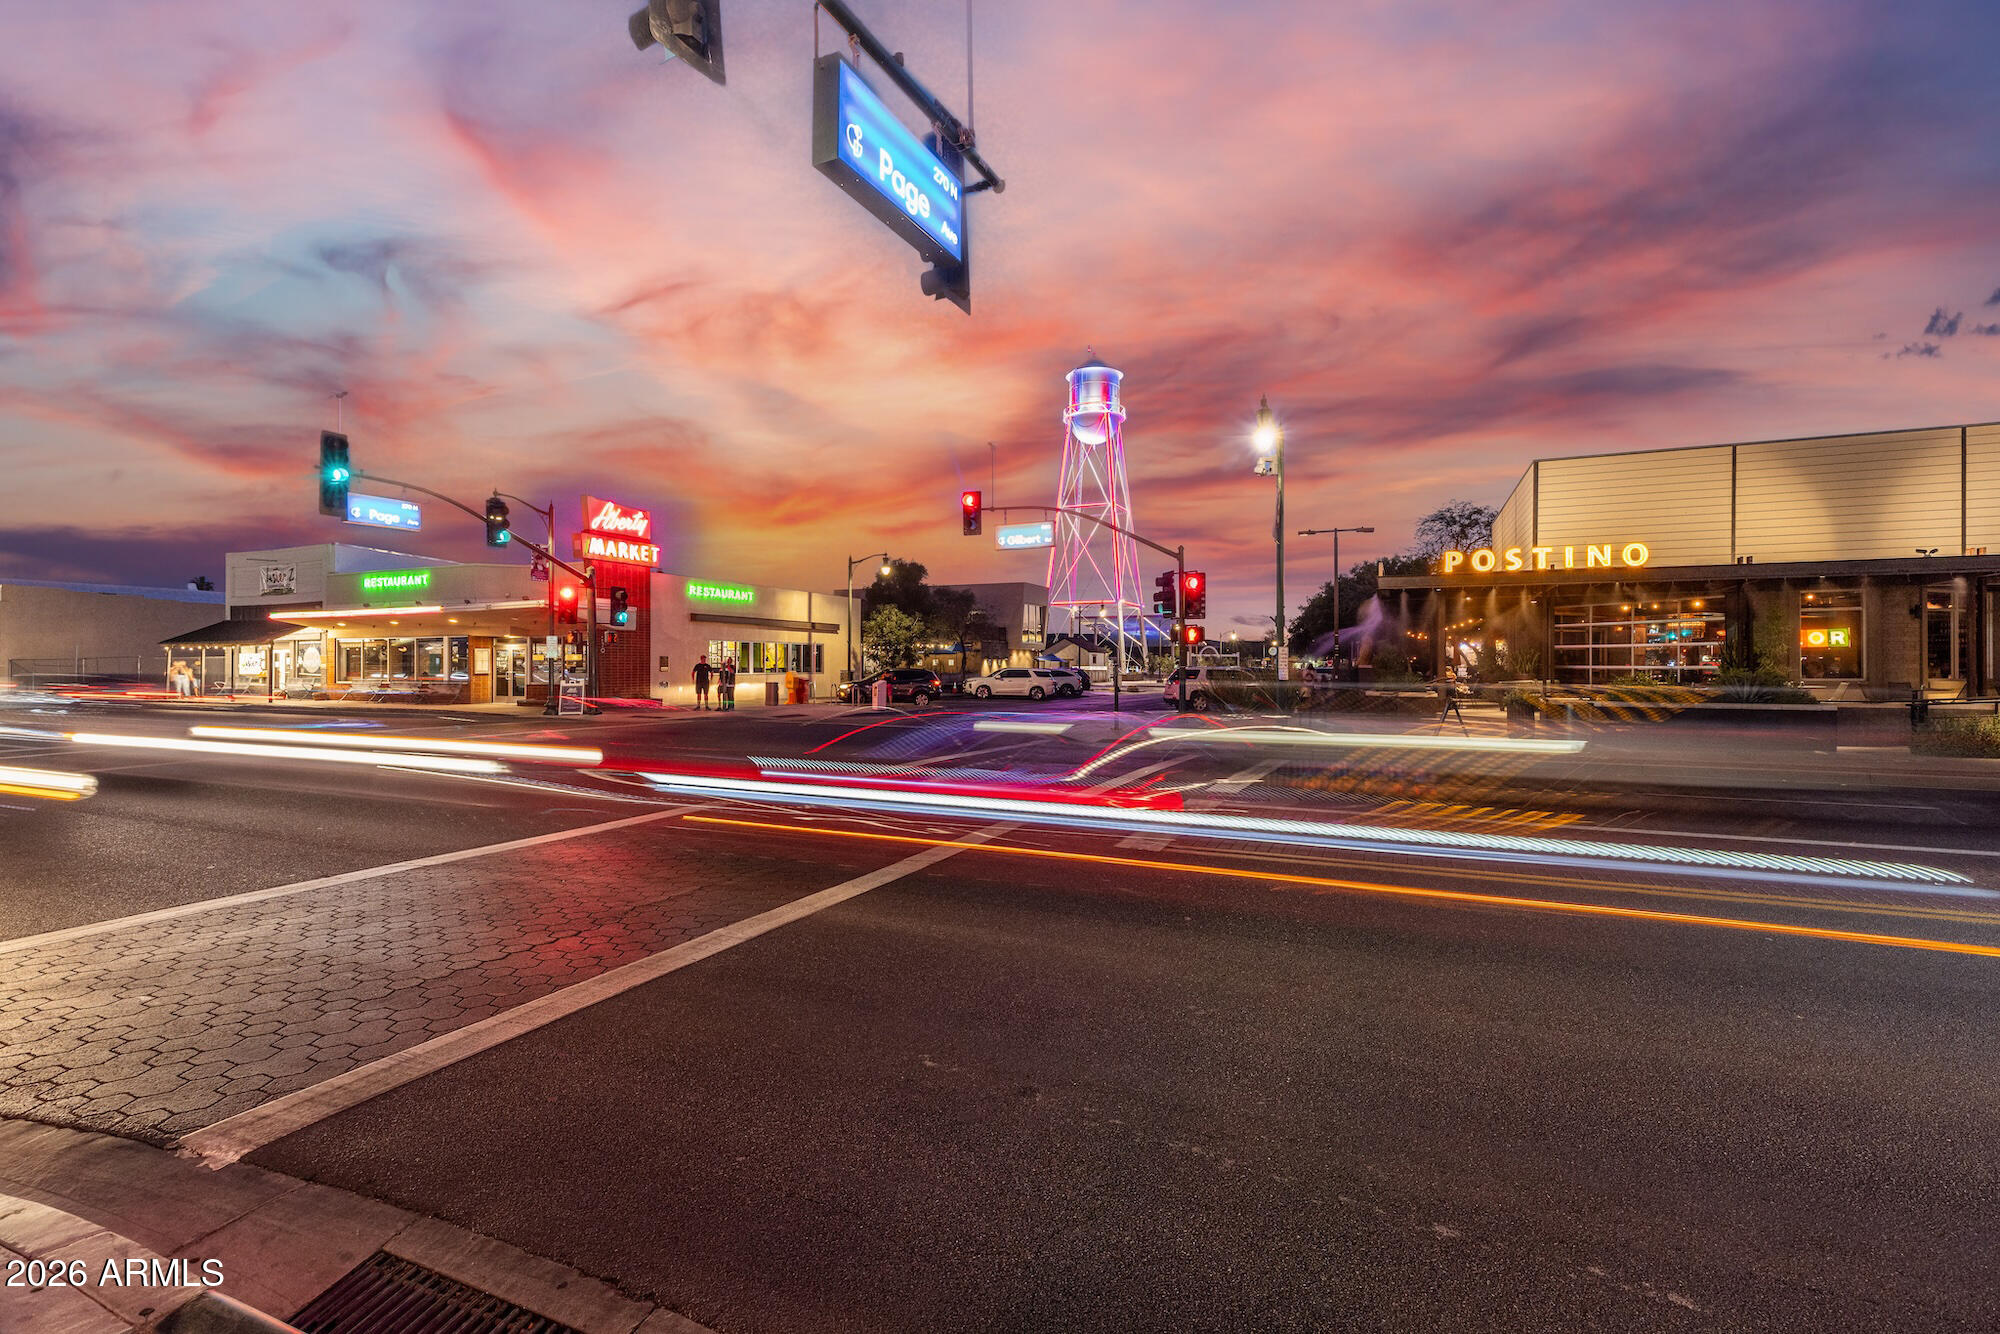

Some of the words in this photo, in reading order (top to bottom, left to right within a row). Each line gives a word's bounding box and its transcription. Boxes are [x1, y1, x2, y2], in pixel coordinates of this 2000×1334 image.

[879, 147, 931, 218] Page
[933, 165, 950, 192] 270
[950, 182, 958, 201] N
[941, 220, 958, 245] Ave
[368, 508, 401, 525] Page
[591, 501, 649, 536] Liberty
[588, 537, 661, 563] MARKET
[1007, 534, 1042, 546] Gilbert
[1442, 542, 1650, 573] POSTINO
[363, 573, 429, 589] RESTAURANT
[688, 584, 754, 602] RESTAURANT
